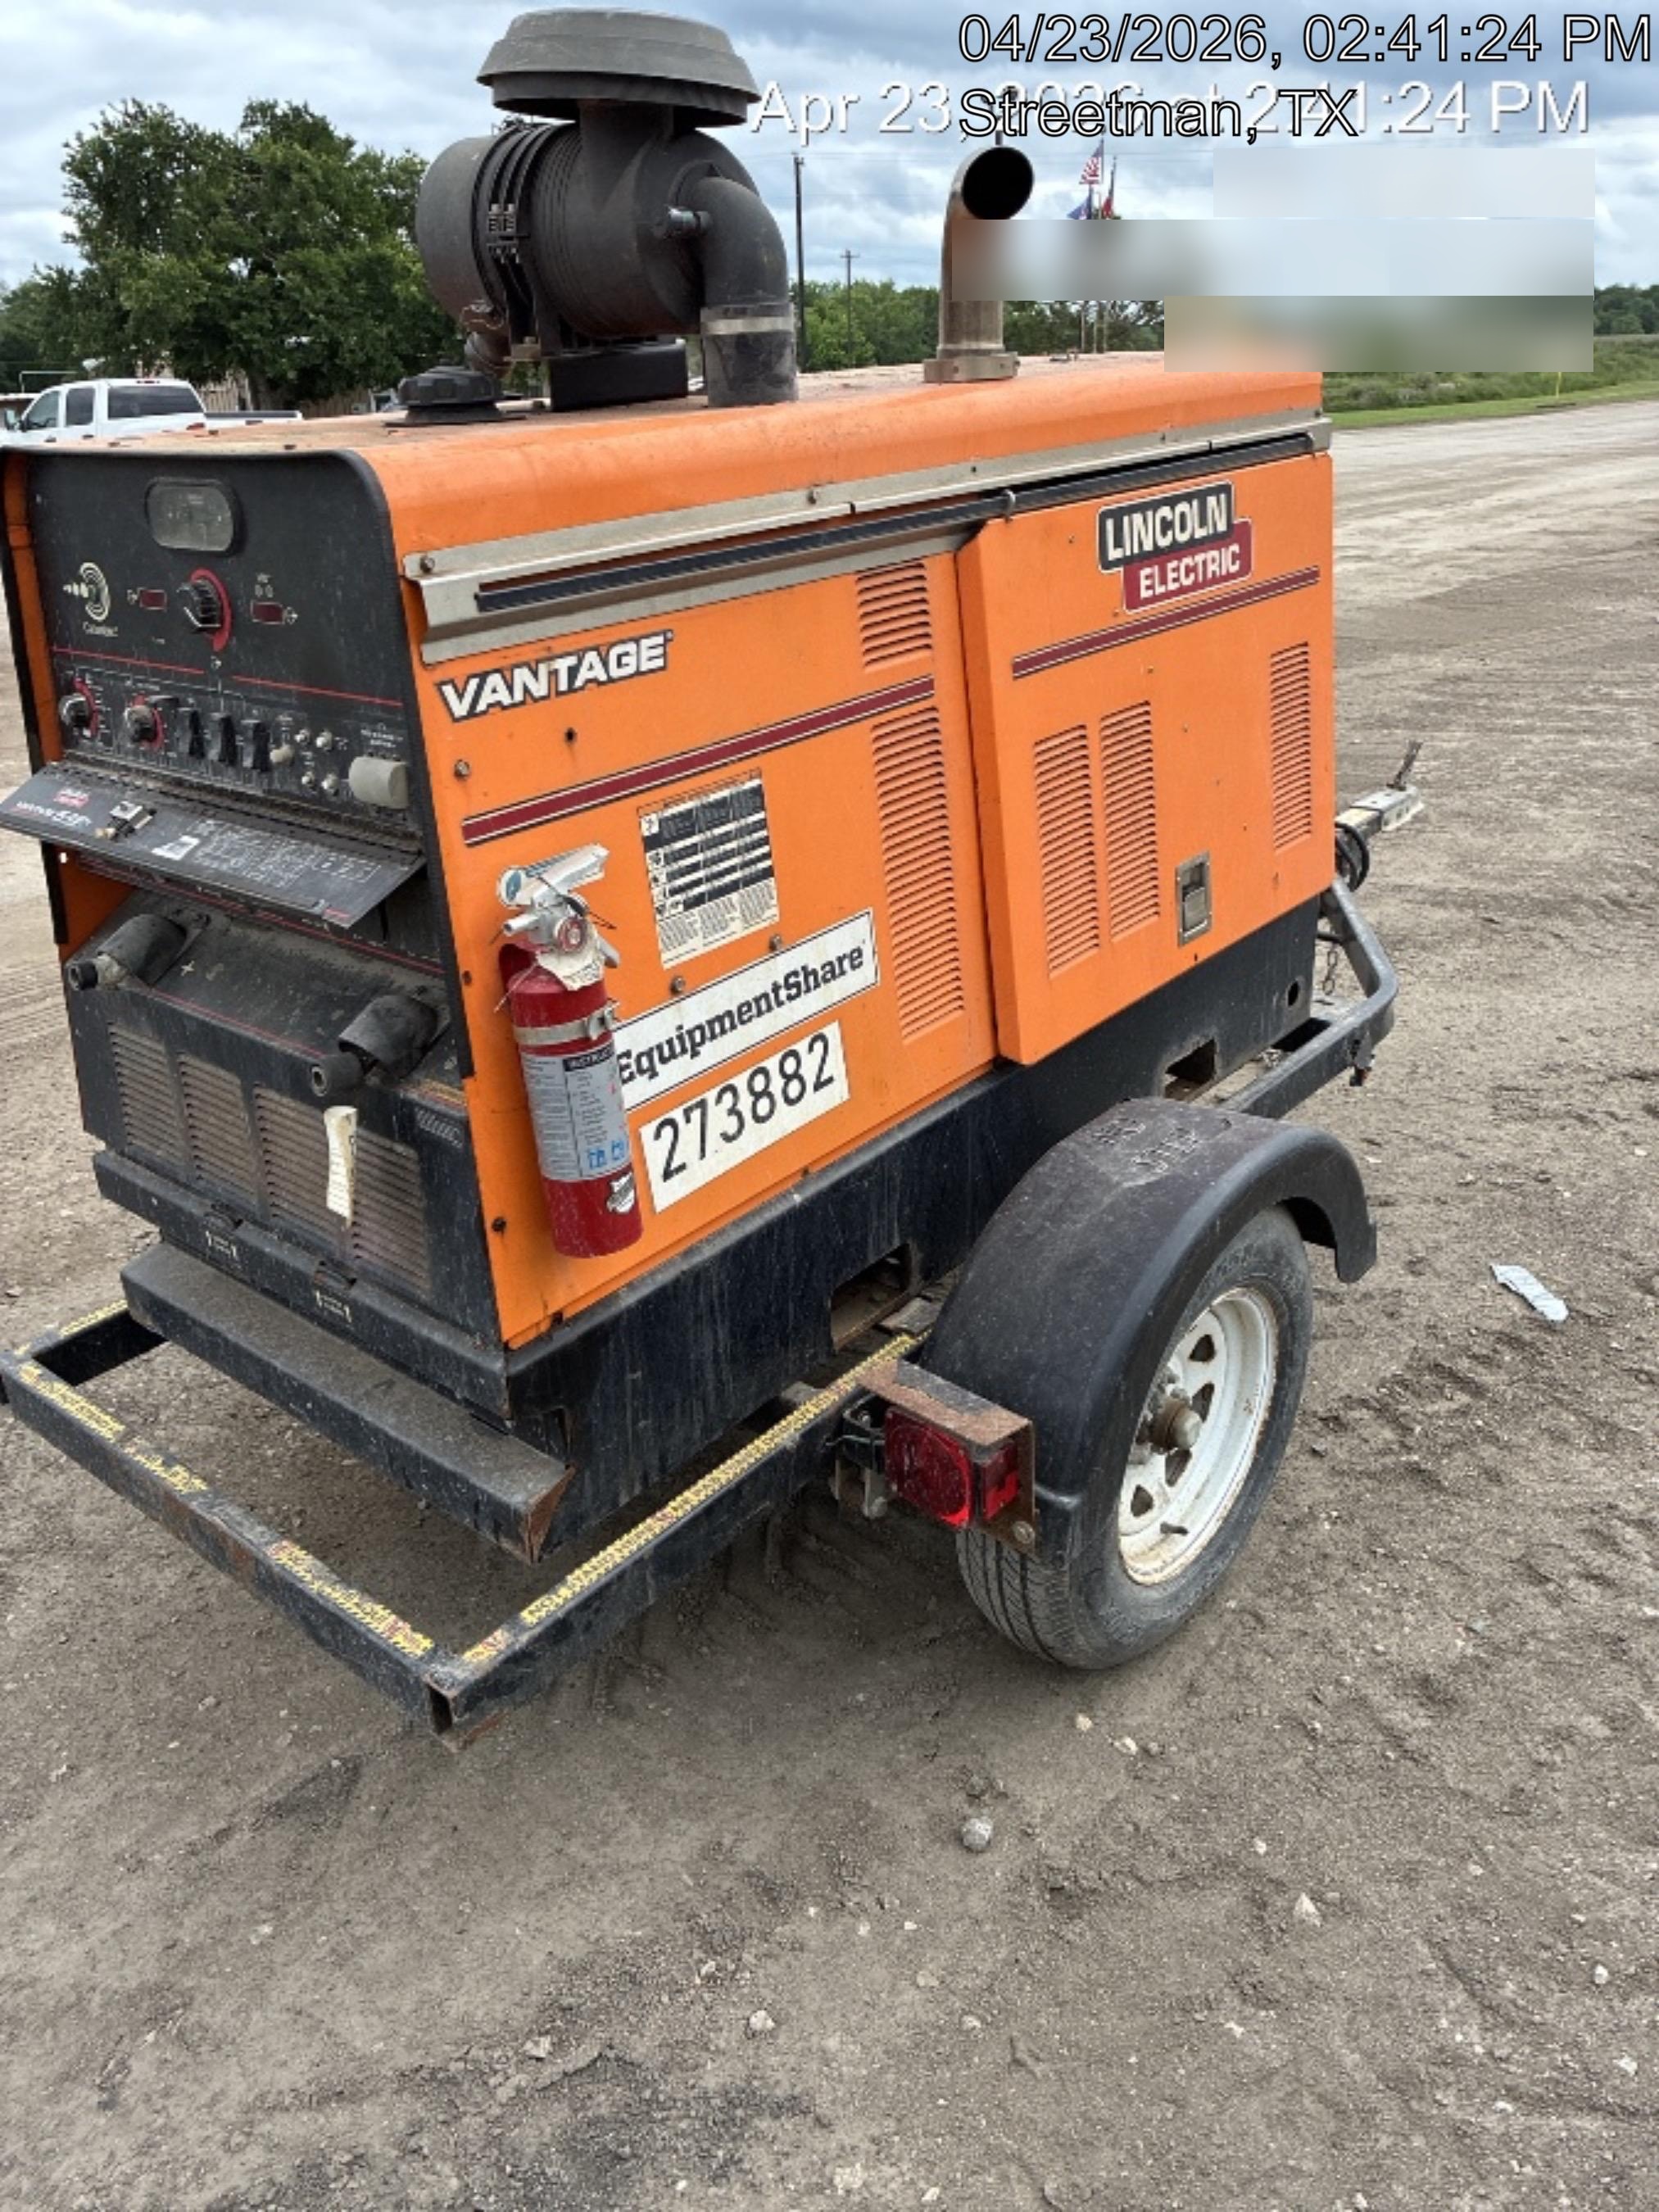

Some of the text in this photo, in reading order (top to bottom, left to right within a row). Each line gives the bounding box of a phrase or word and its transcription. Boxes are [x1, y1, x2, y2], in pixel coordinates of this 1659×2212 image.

[1106, 493, 1228, 561] LINCOLN
[1140, 543, 1240, 600] ELECTRIC
[438, 632, 669, 720] VANTAGE
[617, 945, 864, 1086] EquipmentShare
[653, 1031, 835, 1183] 273882
